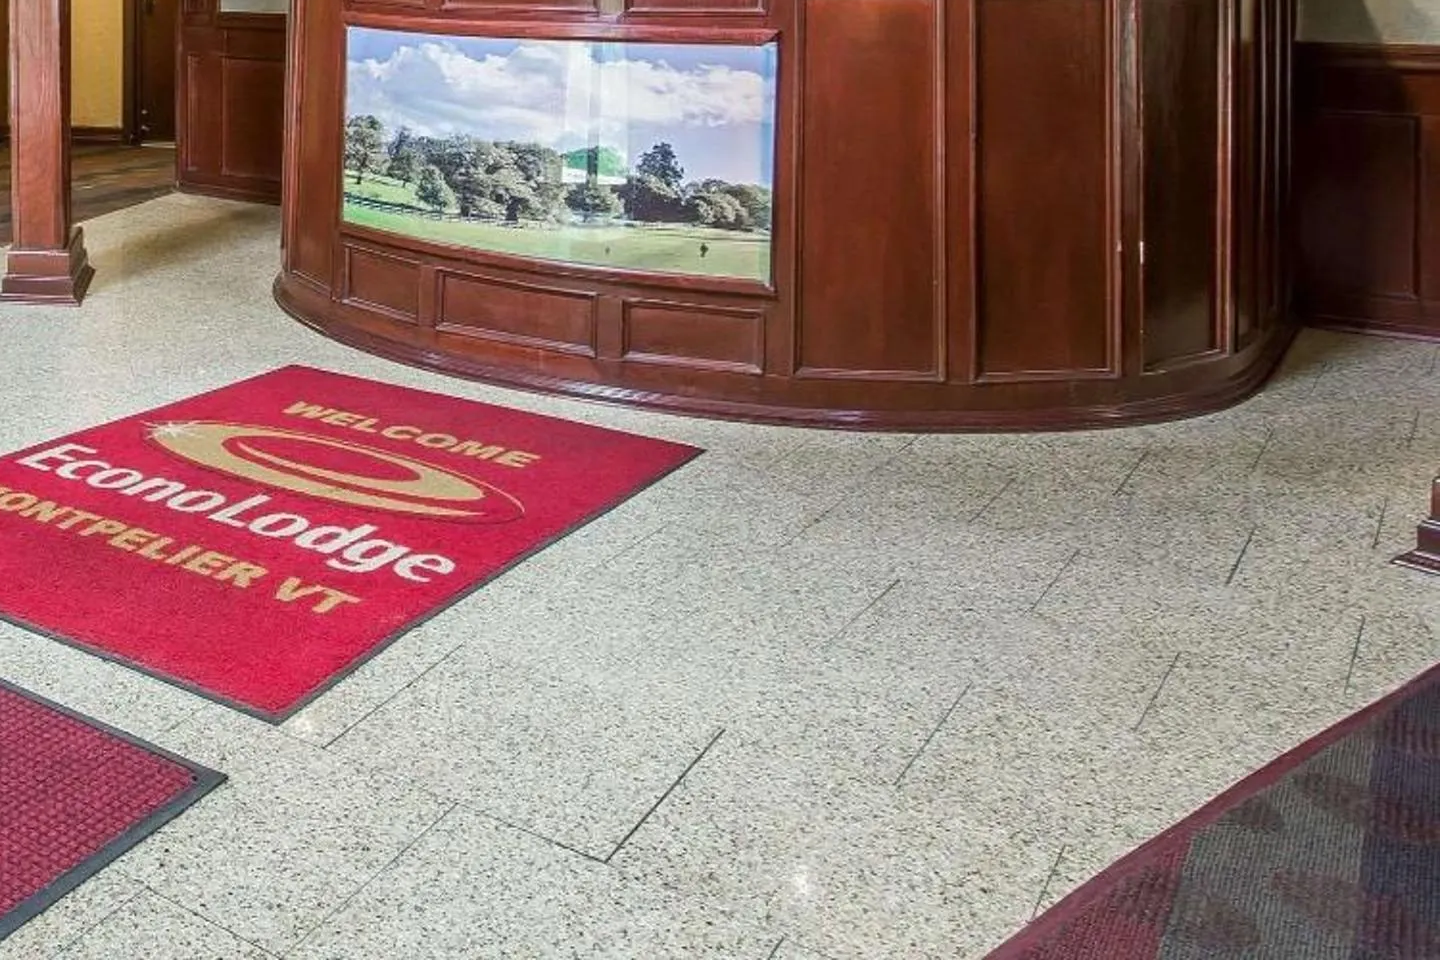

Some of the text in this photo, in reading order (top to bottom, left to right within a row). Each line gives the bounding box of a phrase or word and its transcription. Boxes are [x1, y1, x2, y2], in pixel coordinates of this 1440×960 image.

[282, 401, 541, 468] WELCOME
[15, 442, 457, 583] EconoLodge
[275, 576, 363, 614] VT
